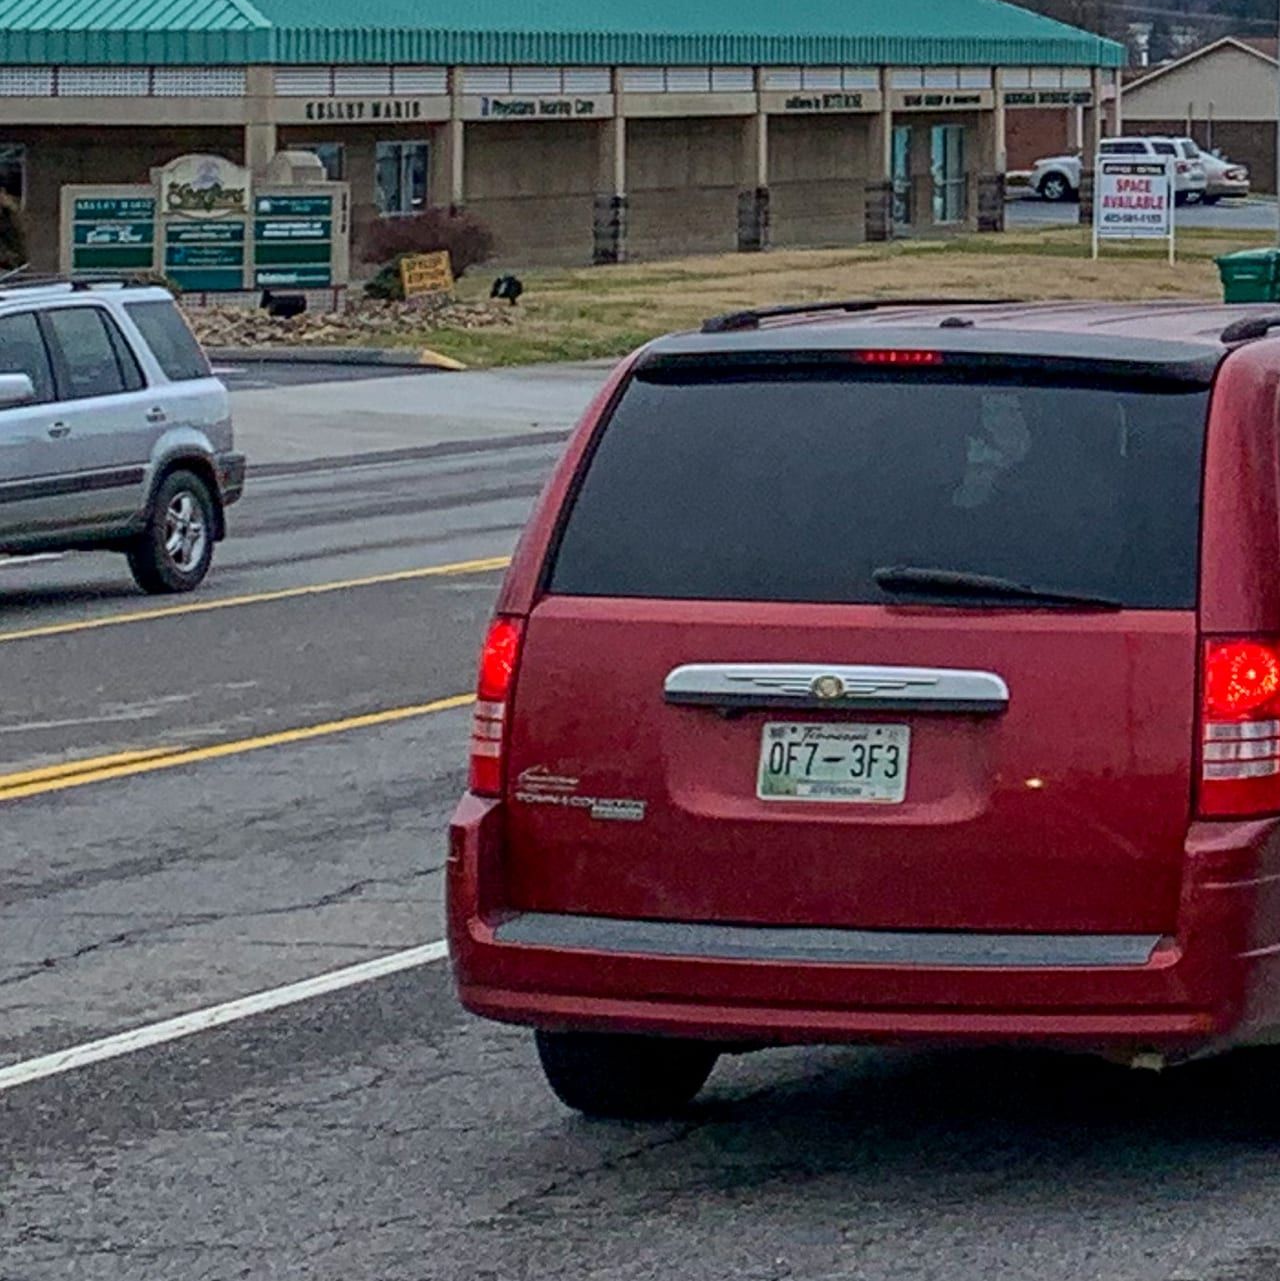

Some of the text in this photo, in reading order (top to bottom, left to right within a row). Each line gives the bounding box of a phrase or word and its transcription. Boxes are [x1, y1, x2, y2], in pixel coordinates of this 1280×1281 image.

[372, 101, 422, 119] MARIE
[1116, 179, 1151, 193] SPACE
[1103, 195, 1163, 210] AVAILABLE
